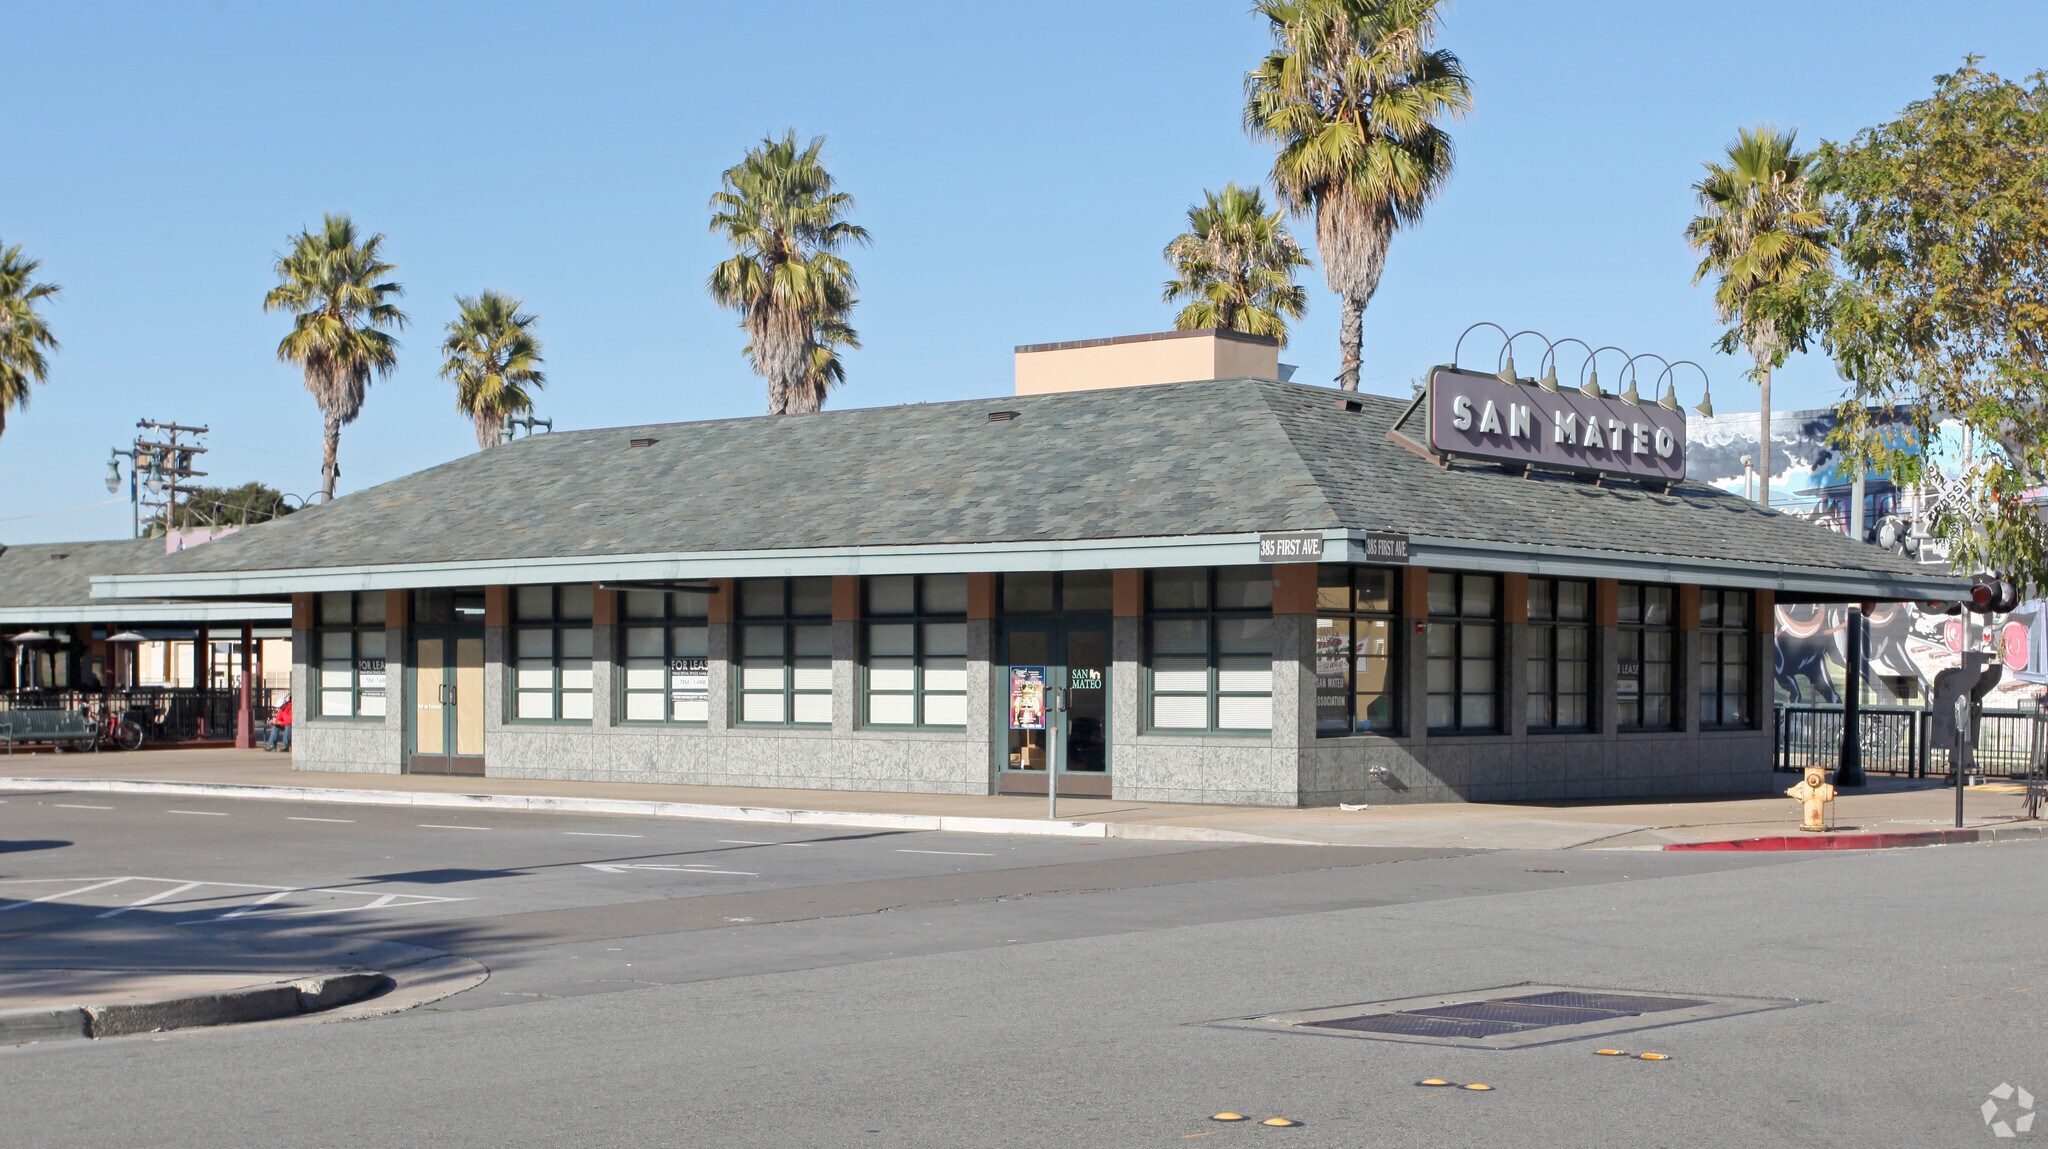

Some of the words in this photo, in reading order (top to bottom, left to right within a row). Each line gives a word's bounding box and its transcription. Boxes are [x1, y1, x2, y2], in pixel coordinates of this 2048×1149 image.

[1453, 395, 1531, 439] SAN
[1554, 410, 1675, 459] MATEO
[1260, 540, 1275, 556] 385
[1276, 538, 1301, 556] FIRST
[1302, 538, 1321, 555] AVE.
[1366, 538, 1377, 555] 385
[1377, 539, 1394, 556] FIRST
[1394, 540, 1408, 557] AVE.
[359, 660, 371, 670] FOR
[672, 660, 688, 671] FOR
[1622, 664, 1640, 675] LEASE
[1072, 669, 1088, 678] SAN
[1072, 680, 1102, 689] MATEO
[1316, 678, 1327, 688] SAN
[1327, 678, 1344, 688] MATEO
[1316, 696, 1346, 706] SSOCIATION
